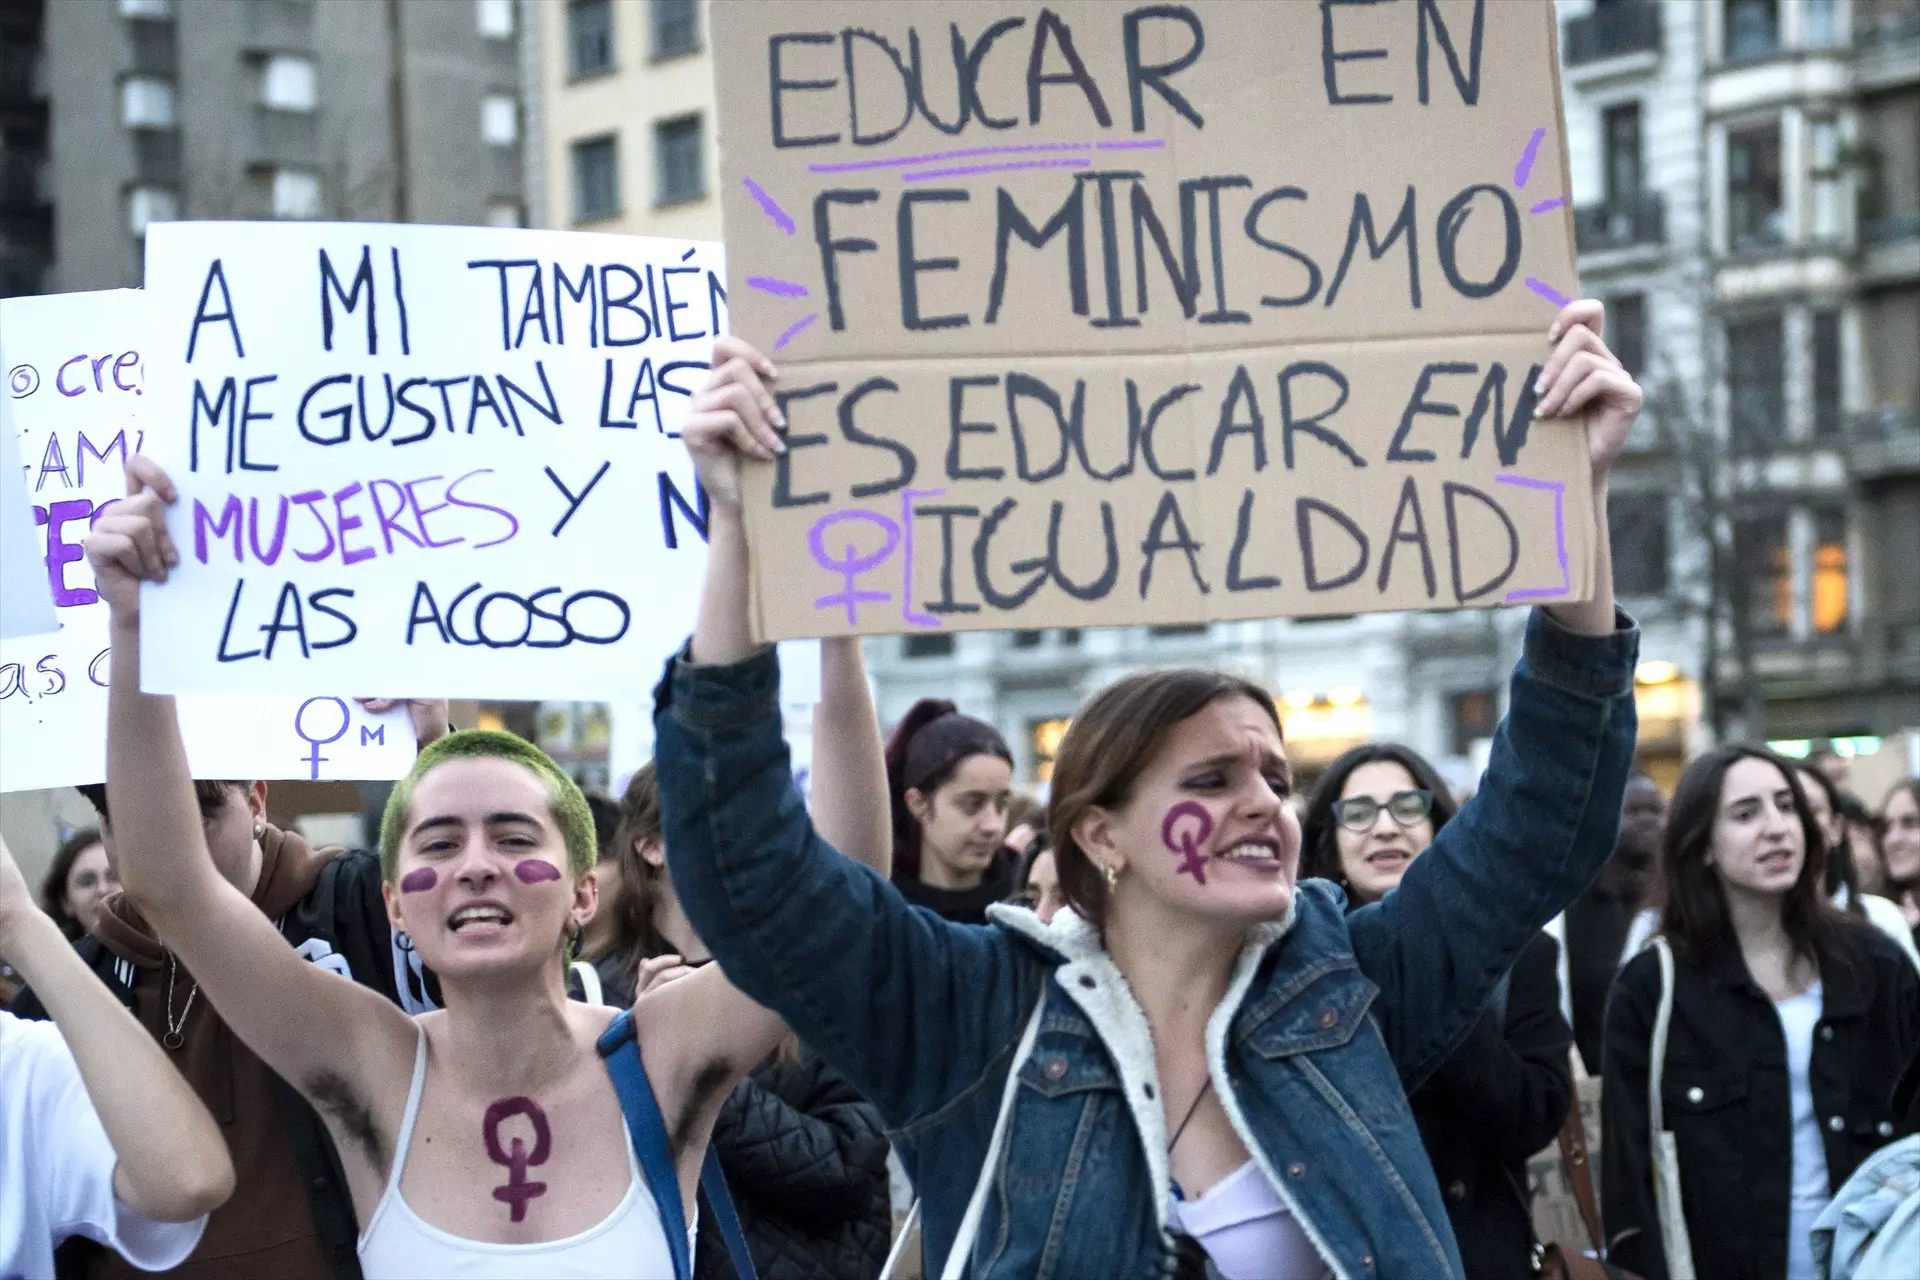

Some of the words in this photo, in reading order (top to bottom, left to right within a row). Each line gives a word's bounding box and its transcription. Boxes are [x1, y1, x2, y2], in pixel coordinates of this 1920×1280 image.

[768, 6, 1204, 149] EDUCAR
[1319, 0, 1485, 106] EN
[187, 258, 244, 363] A
[319, 245, 410, 355] MI
[812, 170, 1522, 332] FEMINISMO
[56, 350, 146, 397] cre
[189, 374, 279, 473] ME
[297, 360, 563, 446] GUSTAN
[599, 358, 711, 438] LAS
[772, 376, 917, 508] ES
[945, 359, 1366, 482] EDUCAR
[1386, 361, 1544, 467] EN
[193, 469, 519, 566] MUJERES
[544, 461, 611, 537] Y
[657, 470, 711, 549] N
[217, 578, 357, 663] LAS
[406, 581, 631, 648] ACOSO
[360, 723, 385, 746] M
